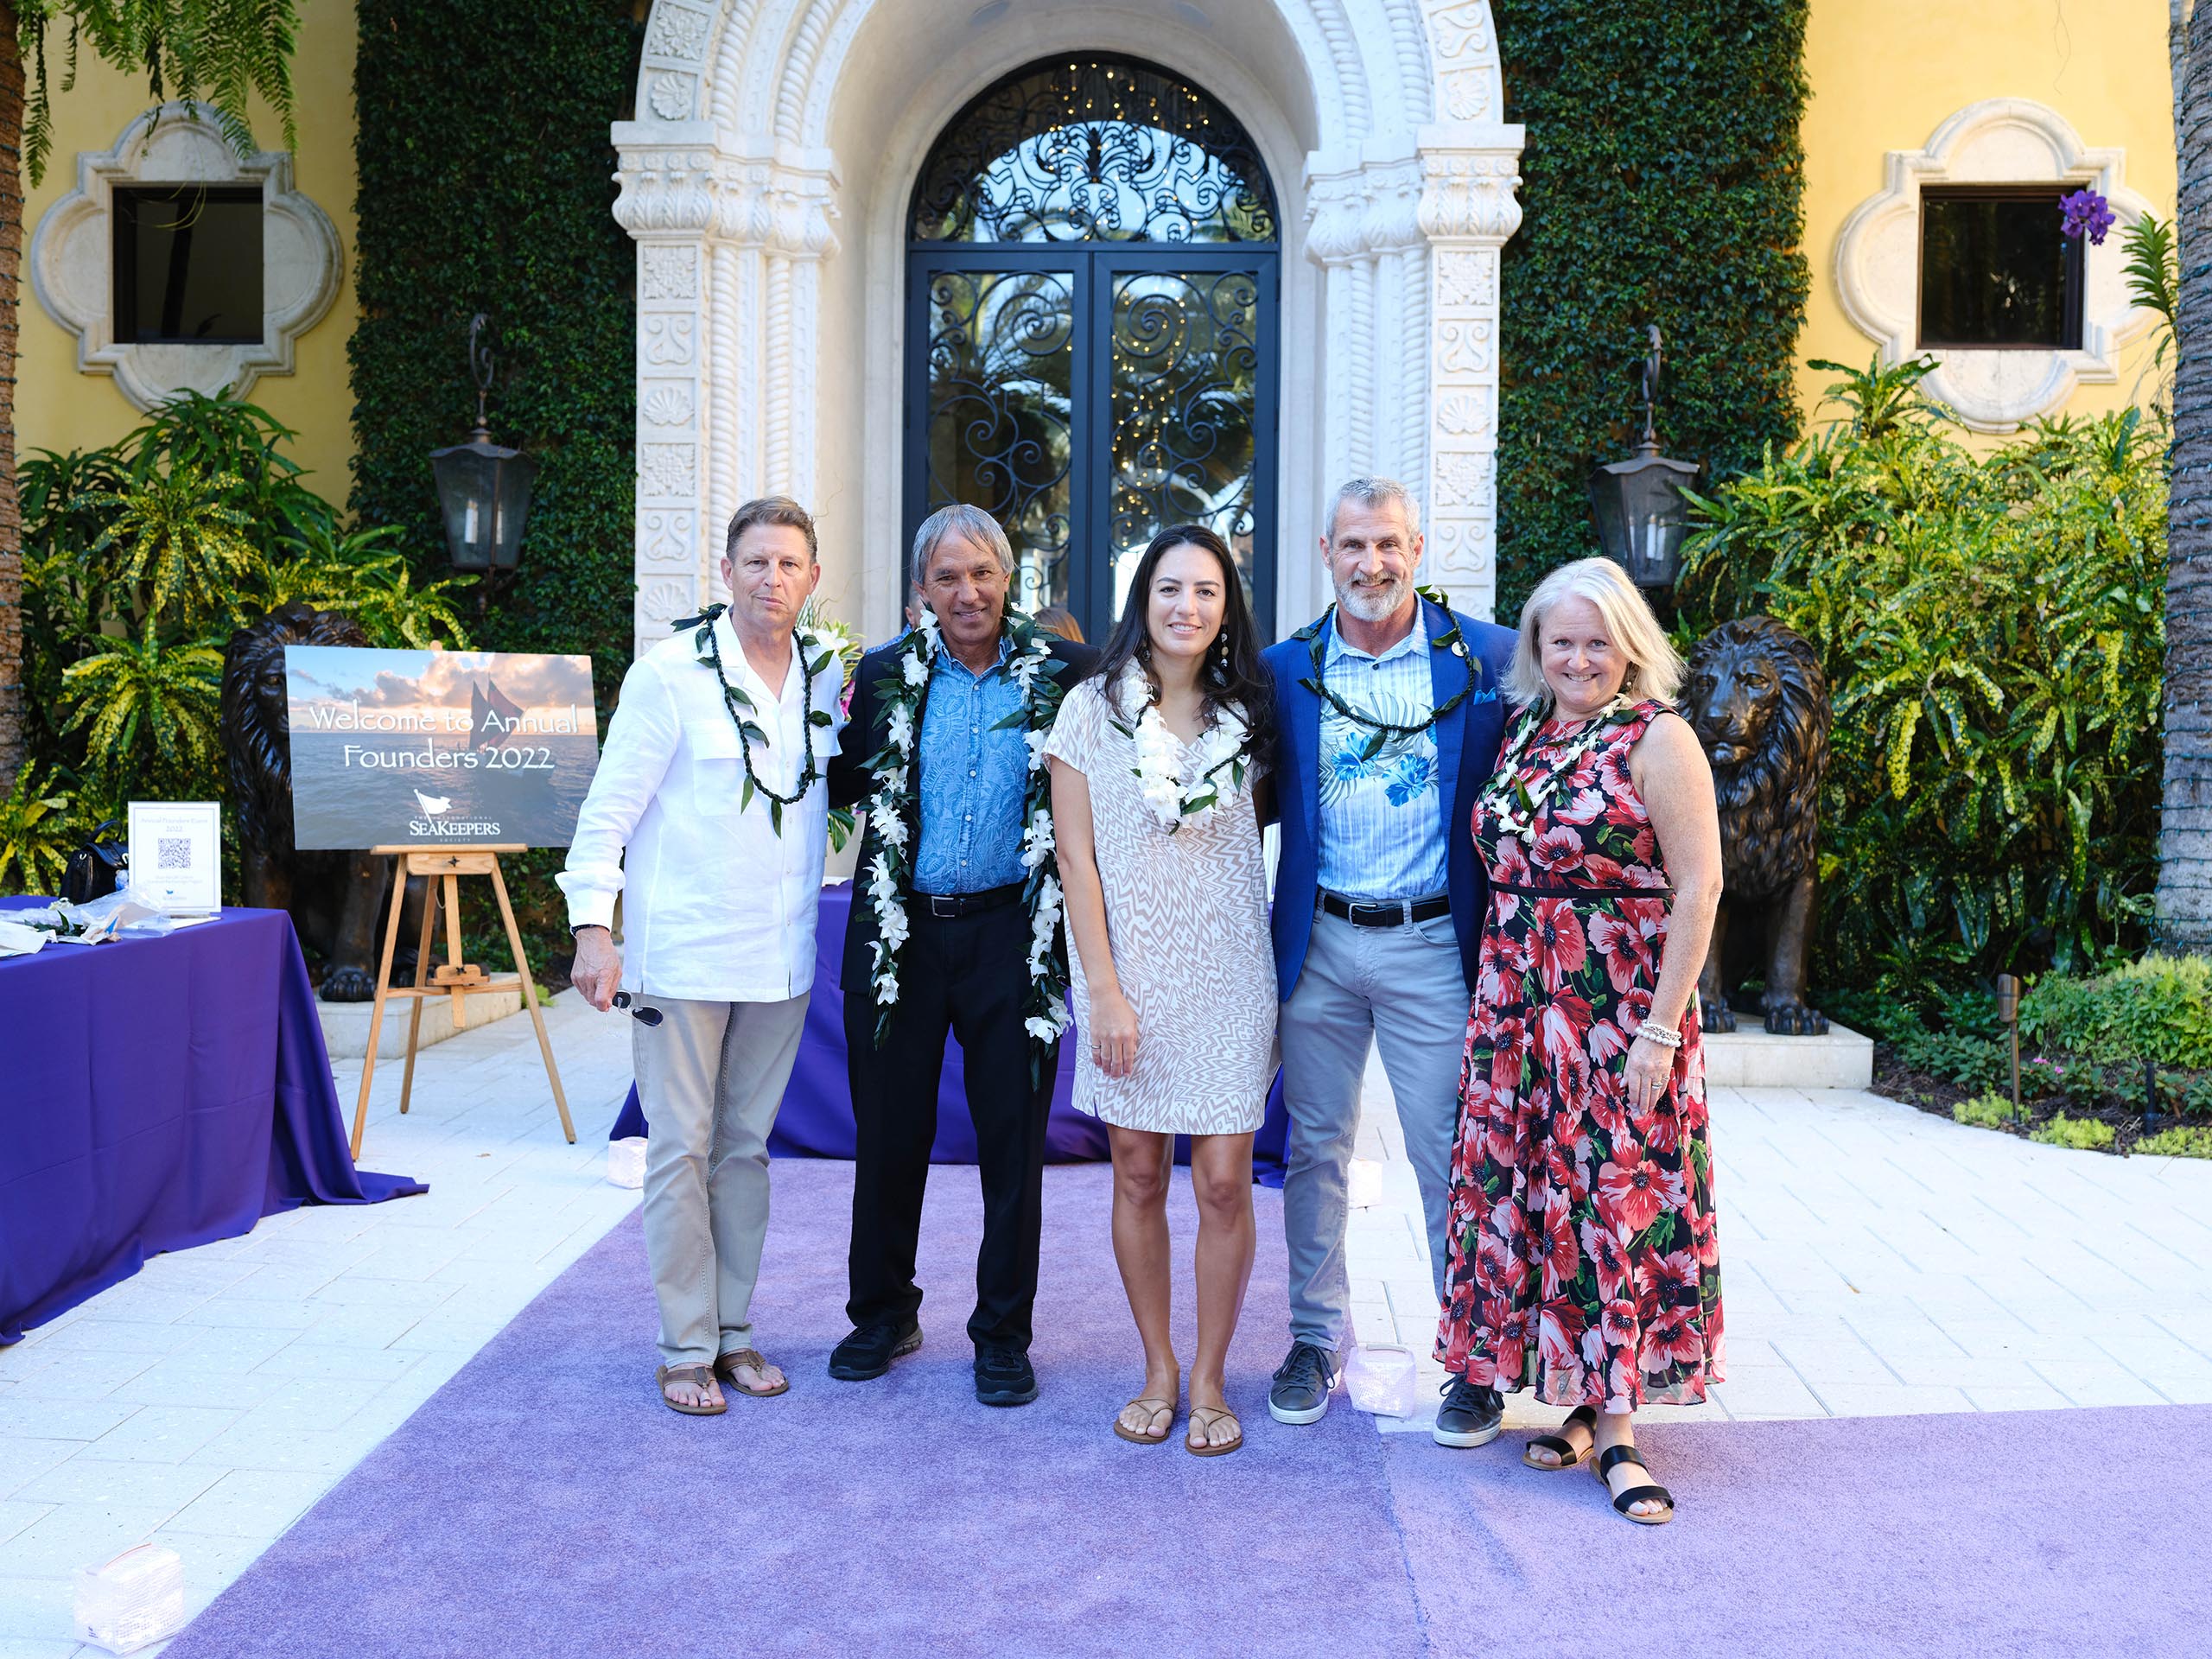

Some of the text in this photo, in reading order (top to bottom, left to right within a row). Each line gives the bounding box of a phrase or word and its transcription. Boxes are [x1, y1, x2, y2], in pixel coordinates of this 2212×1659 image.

[309, 698, 578, 734] Welcome to Annual
[344, 737, 556, 769] Founders 2022
[409, 820, 501, 836] SEAKEEPERS
